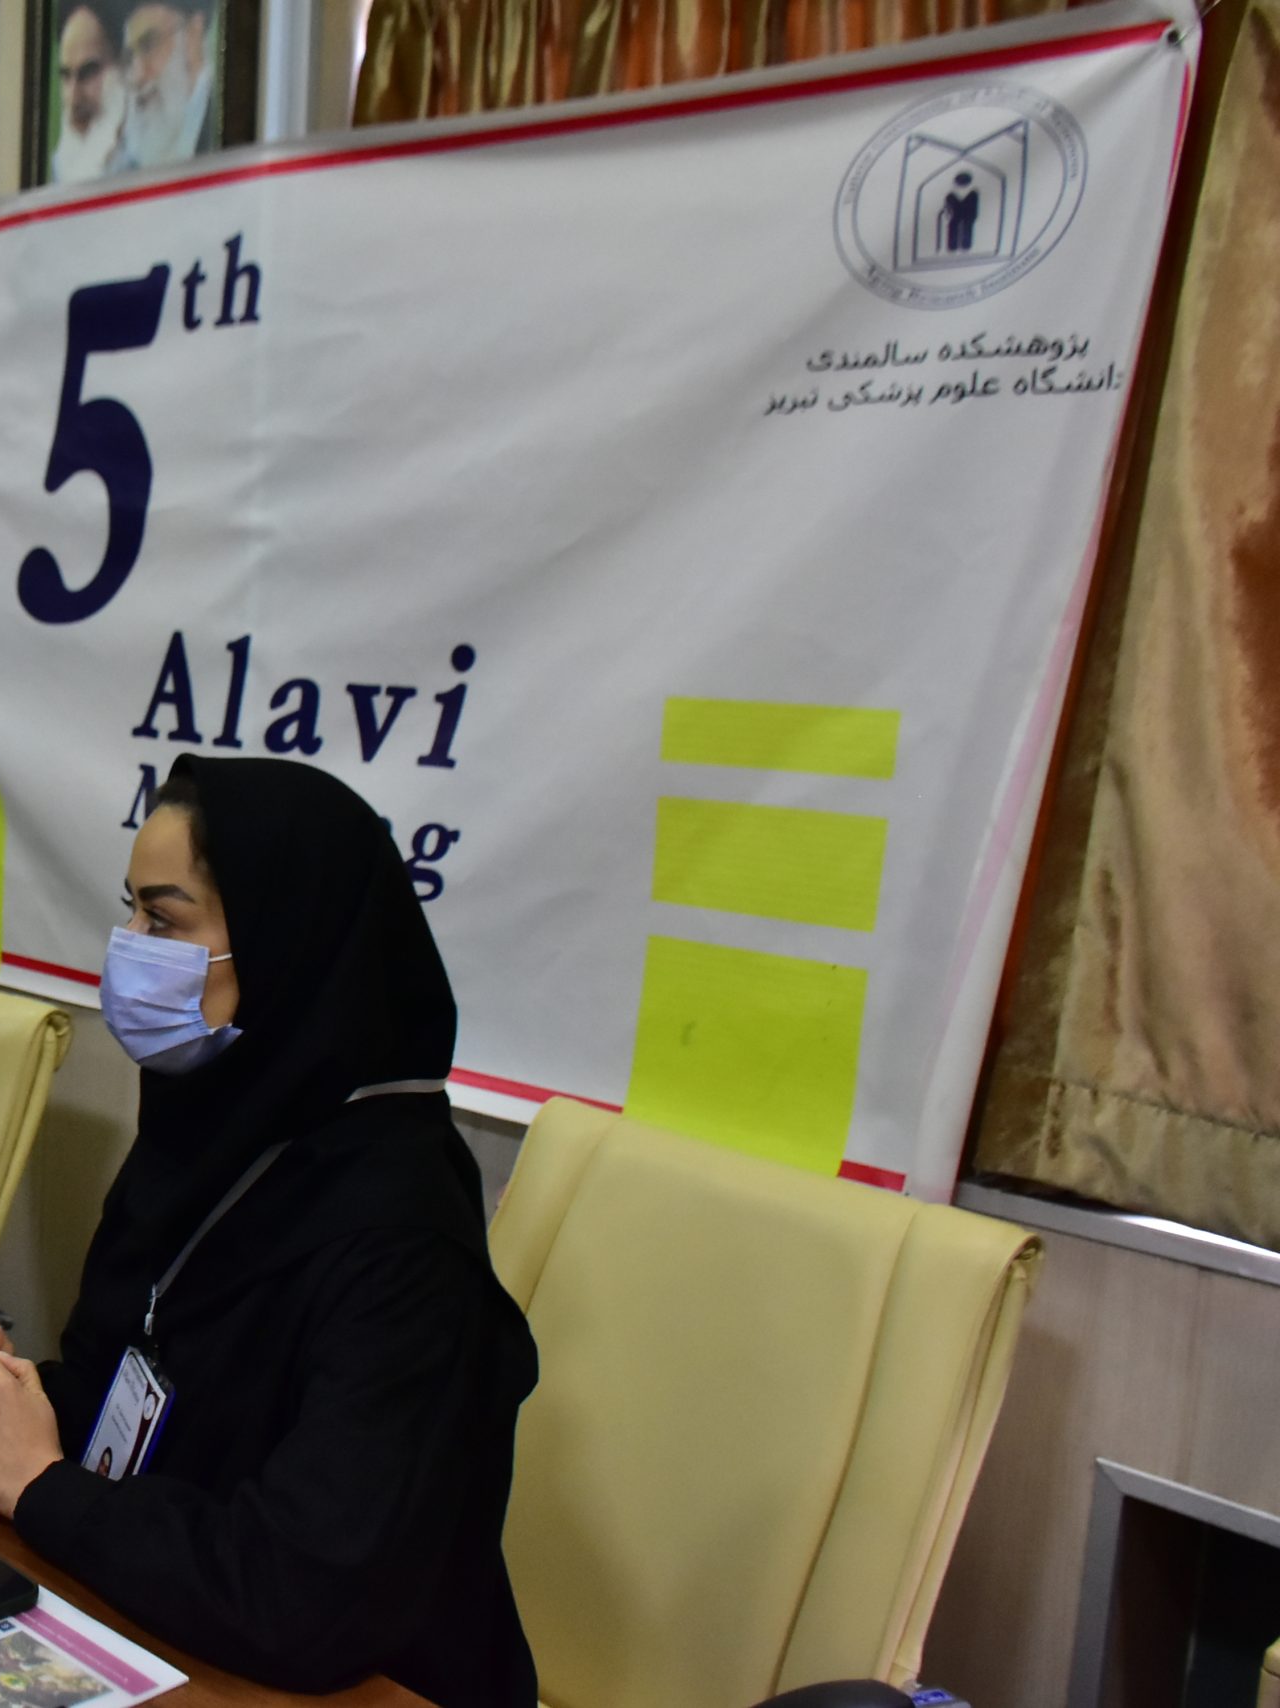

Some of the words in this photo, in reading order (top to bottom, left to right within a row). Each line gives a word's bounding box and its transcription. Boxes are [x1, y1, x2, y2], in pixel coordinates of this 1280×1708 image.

[806, 339, 928, 373] سالمندی
[938, 332, 1090, 362] پژوهشکده
[763, 387, 819, 416] تبریز
[826, 380, 924, 412] پزشکی
[931, 369, 1000, 406] علوم
[16, 232, 263, 626] 5th
[131, 631, 476, 770] Alavi
